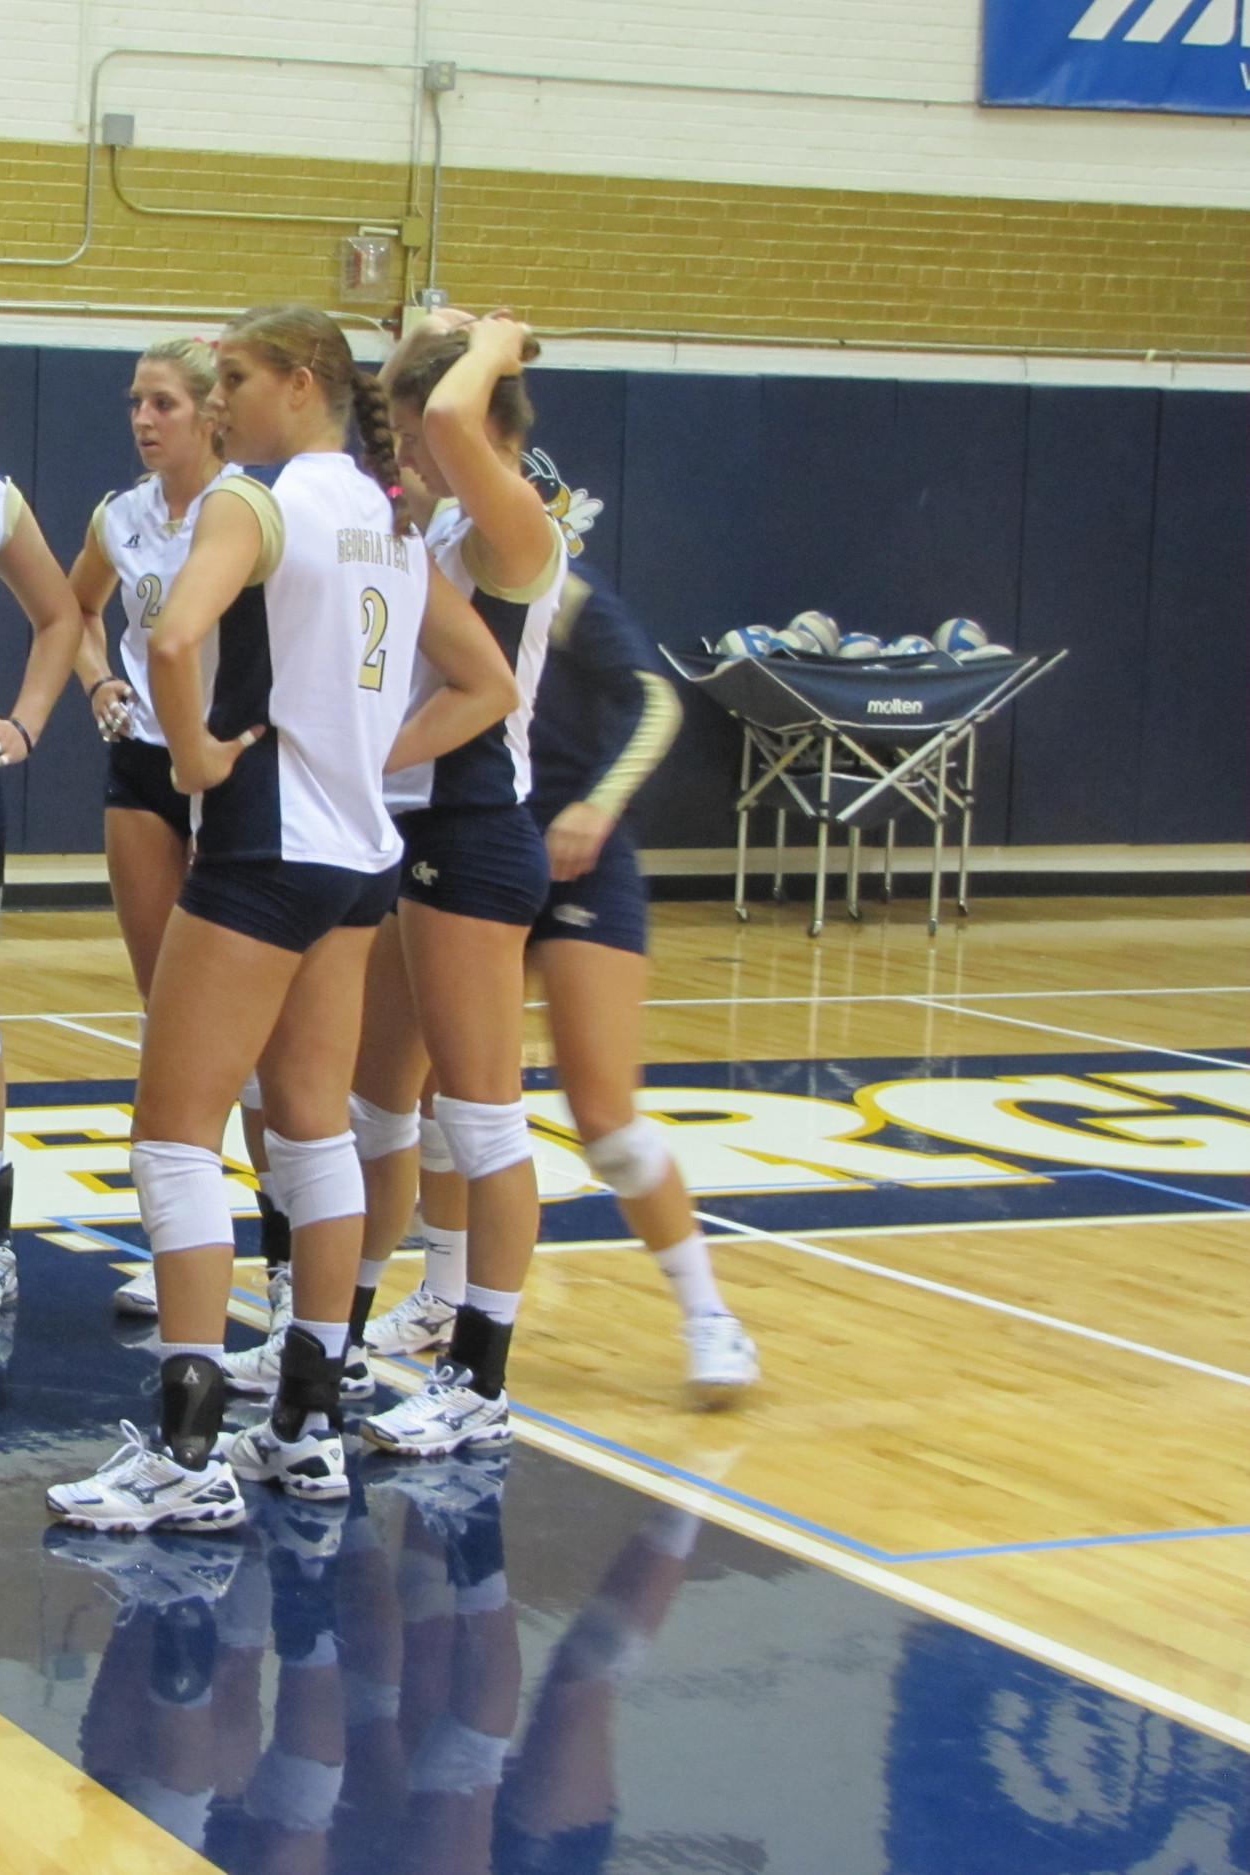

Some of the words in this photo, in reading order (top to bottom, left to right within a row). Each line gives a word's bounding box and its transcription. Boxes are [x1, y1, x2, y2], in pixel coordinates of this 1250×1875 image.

[336, 528, 383, 565] GEORGIA
[136, 573, 163, 628] 2
[358, 586, 388, 692] 2
[866, 698, 923, 714] molten
